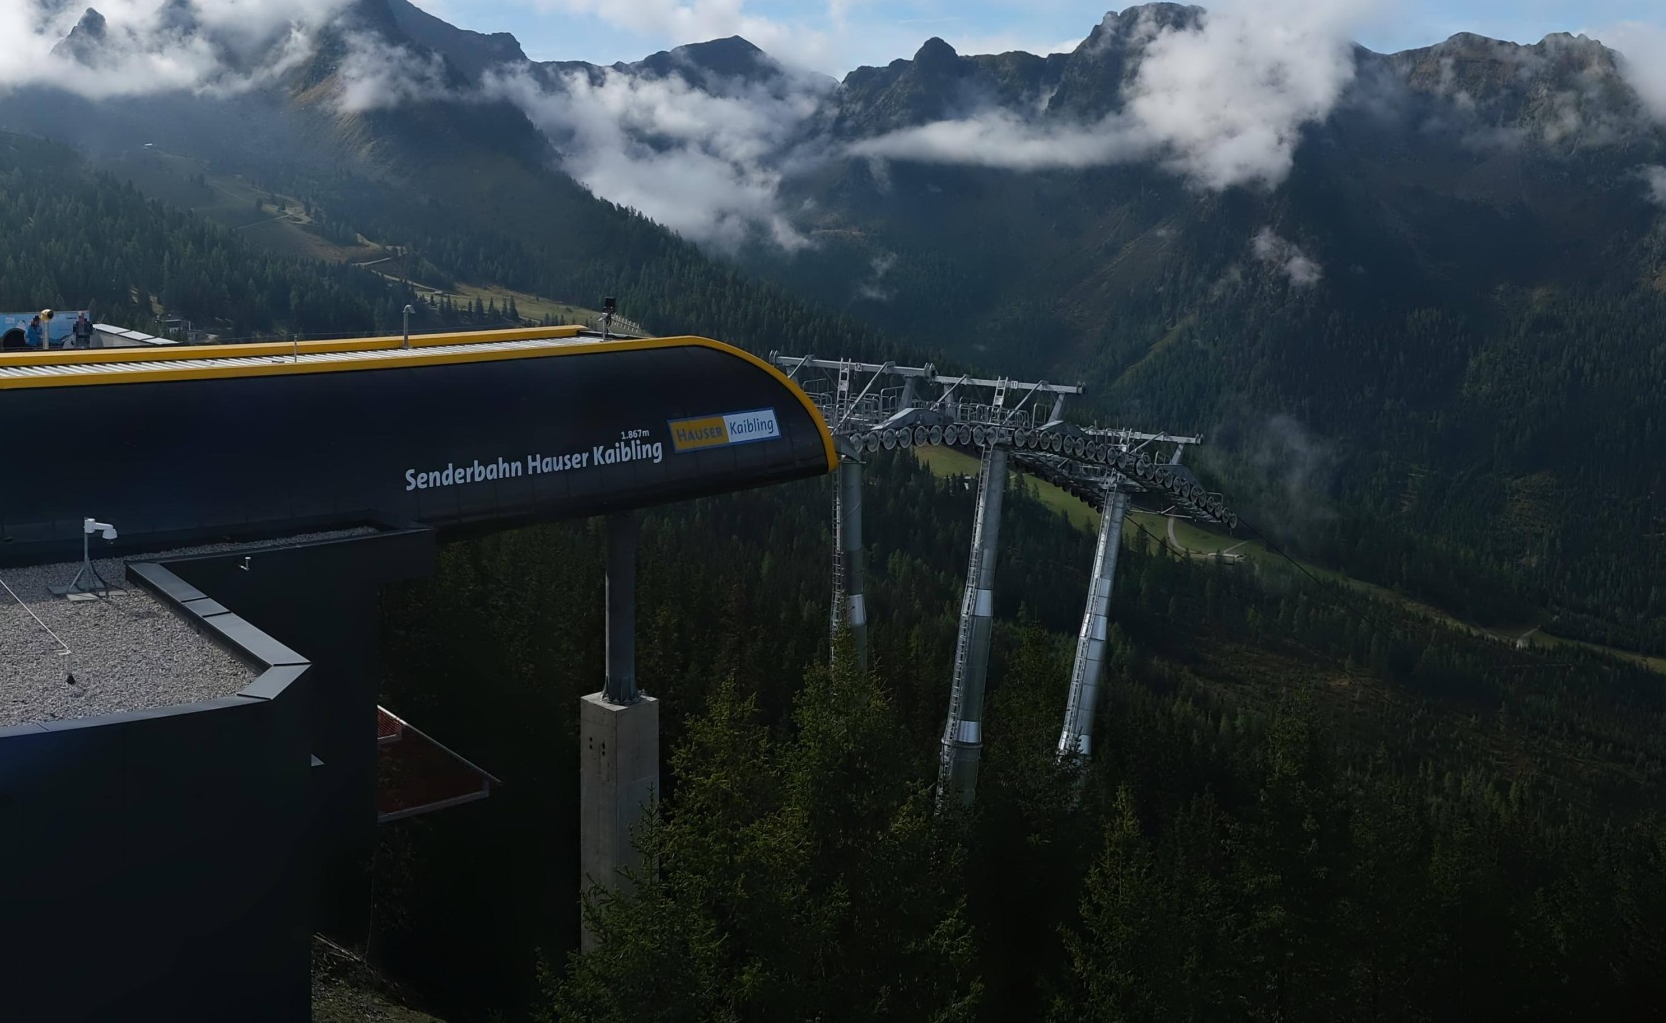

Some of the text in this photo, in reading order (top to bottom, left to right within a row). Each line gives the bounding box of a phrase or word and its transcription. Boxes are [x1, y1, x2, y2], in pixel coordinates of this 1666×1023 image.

[620, 429, 650, 440] 1.867m
[676, 417, 775, 443] HAUSER Kaibling
[405, 439, 663, 491] Senderbahn Hauser Kaibling
